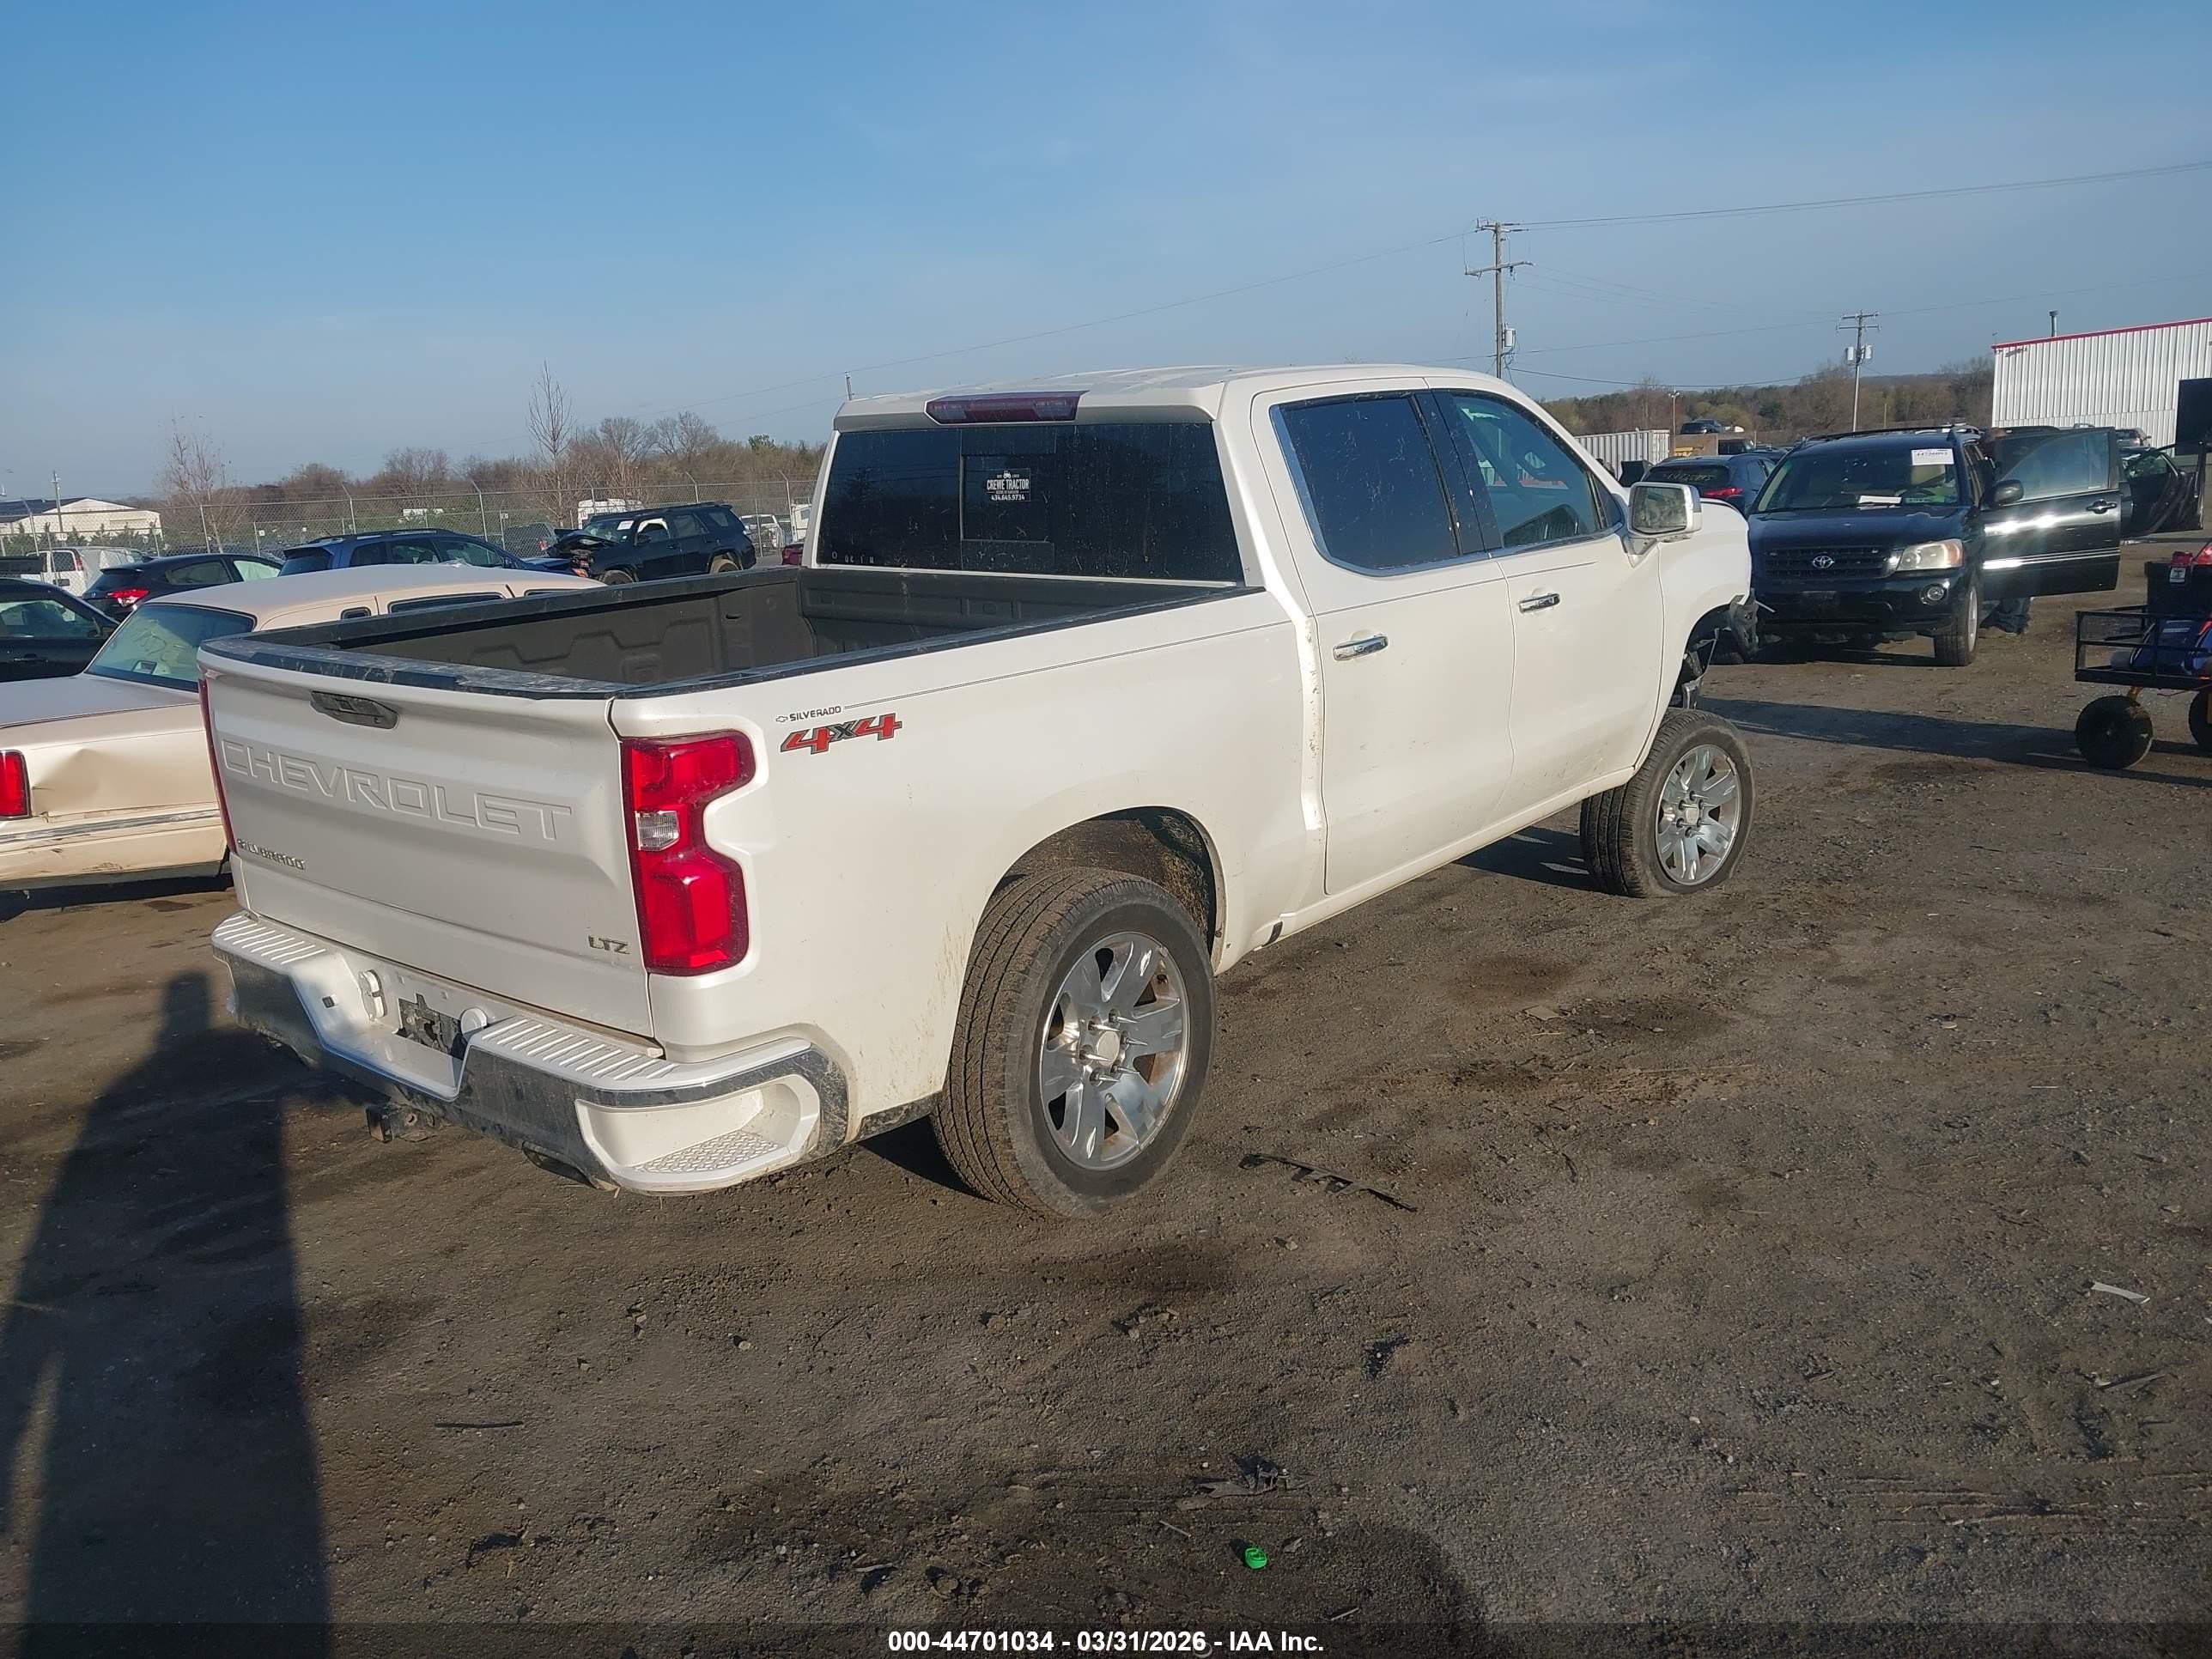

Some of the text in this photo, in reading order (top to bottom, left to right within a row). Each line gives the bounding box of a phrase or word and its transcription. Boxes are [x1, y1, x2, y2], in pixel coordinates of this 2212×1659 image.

[987, 478, 1030, 490] CREWE TRACTOR
[789, 705, 842, 721] SILVERADO
[221, 738, 573, 840] CHEVROLET
[588, 935, 630, 955] LTZ
